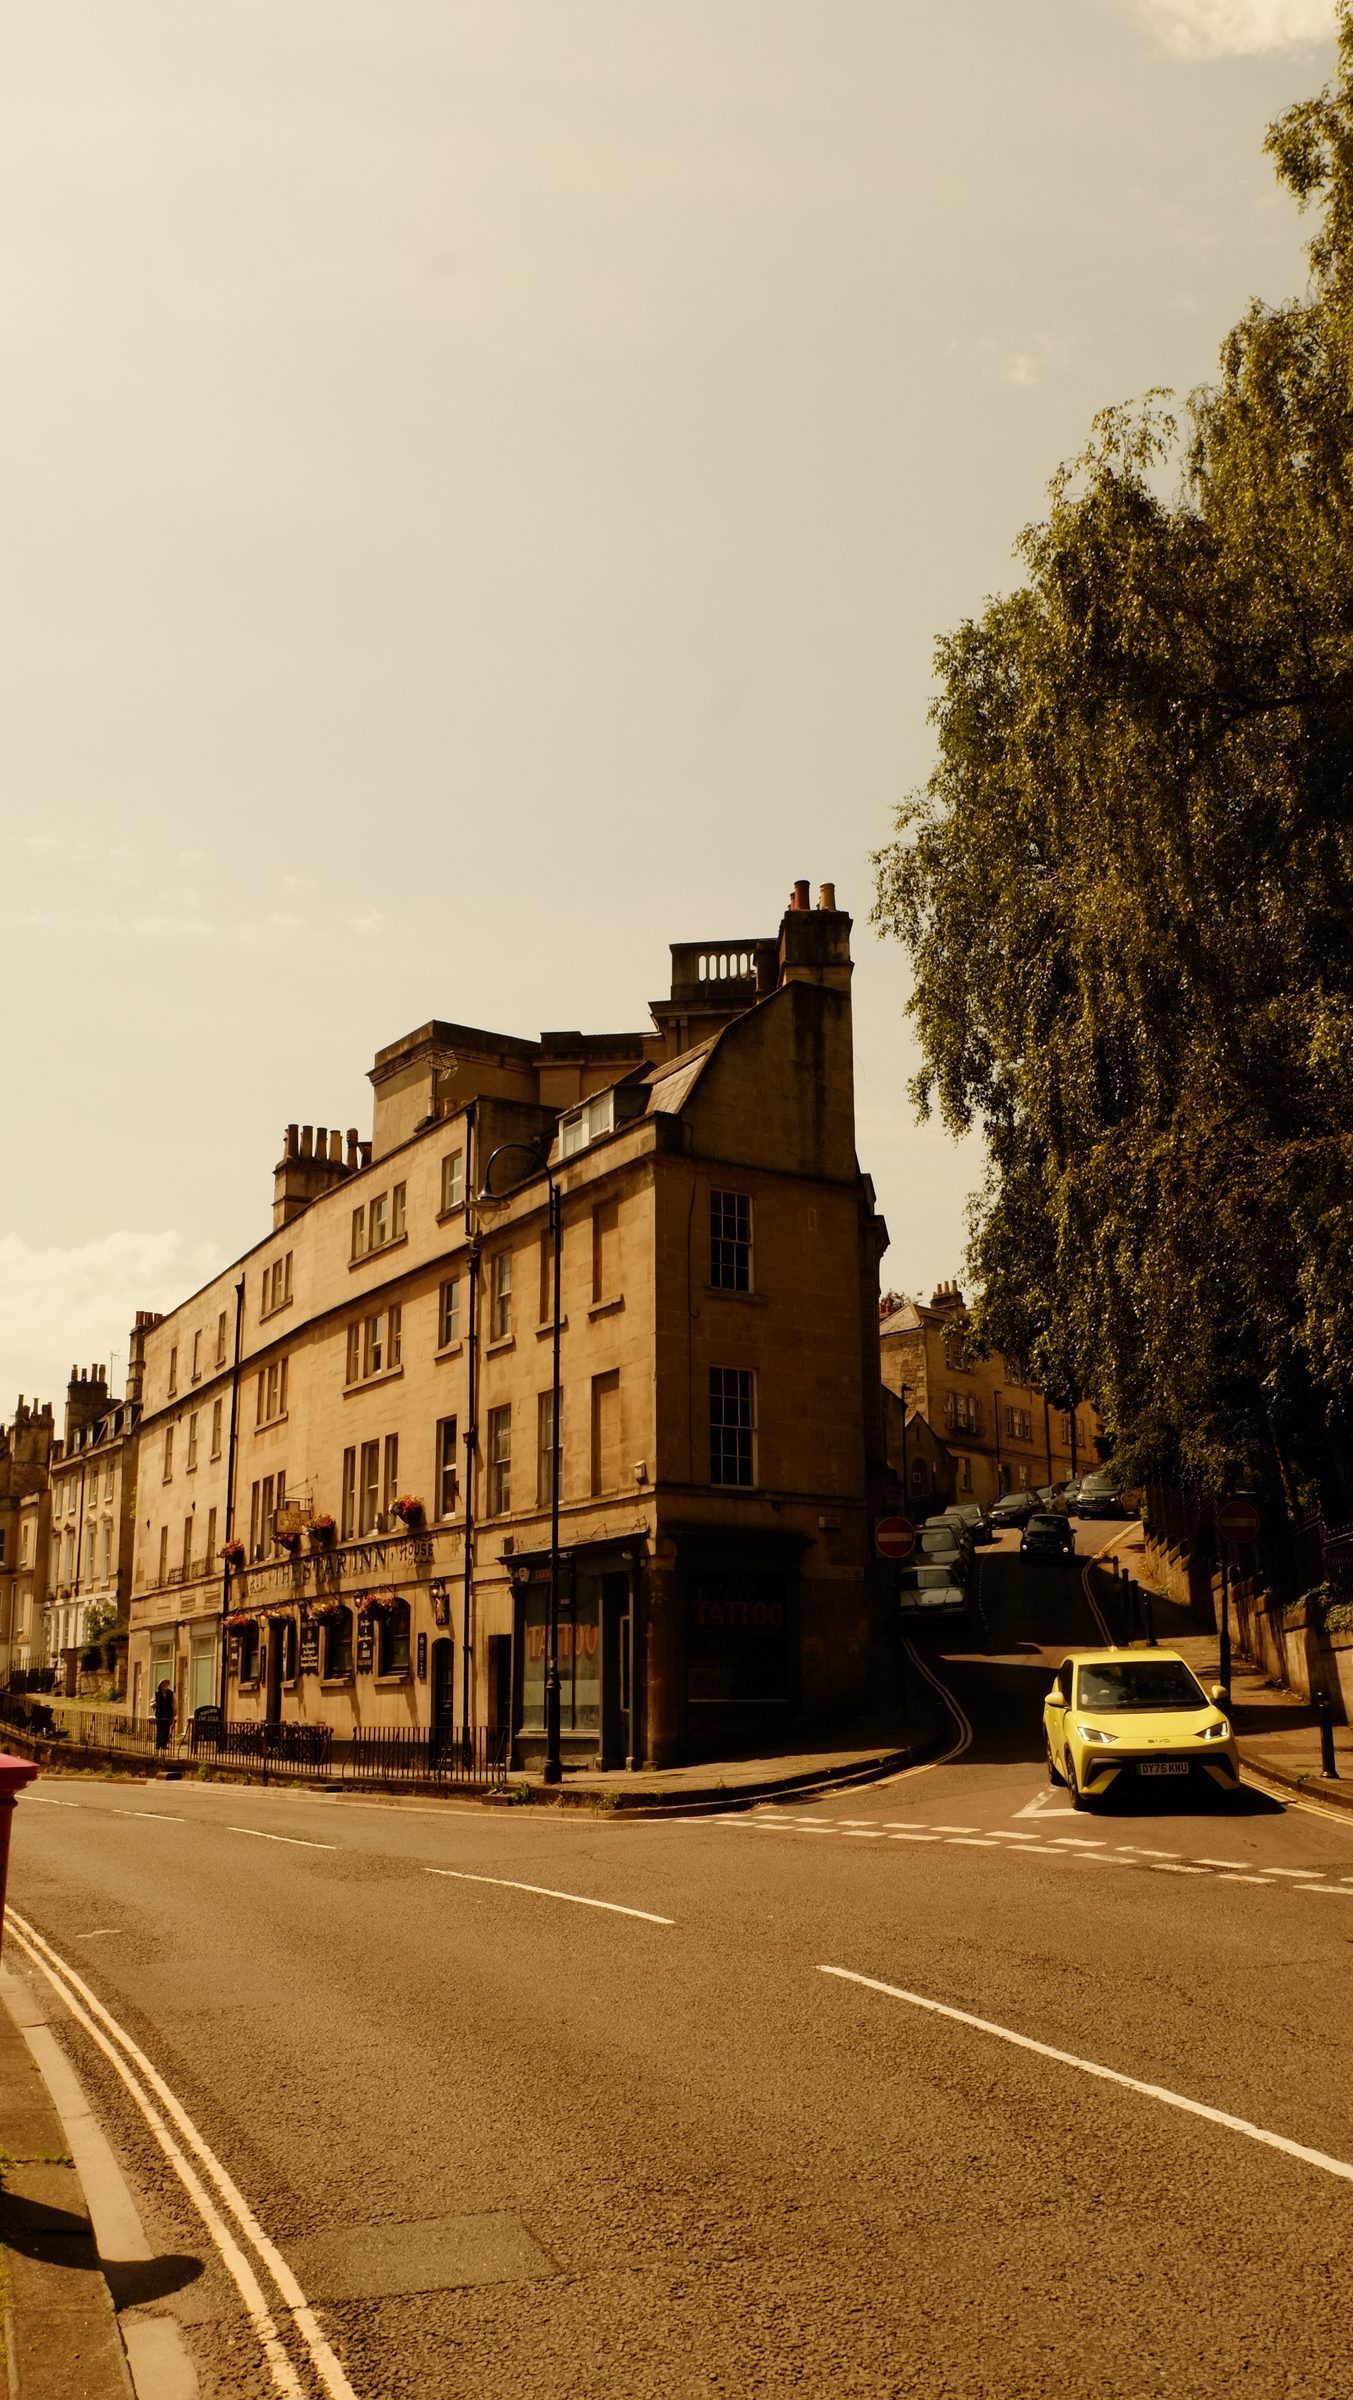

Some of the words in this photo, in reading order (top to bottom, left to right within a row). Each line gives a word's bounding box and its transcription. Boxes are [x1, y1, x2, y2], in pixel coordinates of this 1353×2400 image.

[272, 1562, 298, 1588] THE
[303, 1551, 347, 1582] STAR
[352, 1545, 387, 1573] INN
[399, 1540, 434, 1561] HOUSE
[692, 1600, 784, 1626] TATTOO
[527, 1623, 598, 1657] TATOO
[1142, 1764, 1167, 1773] DY75
